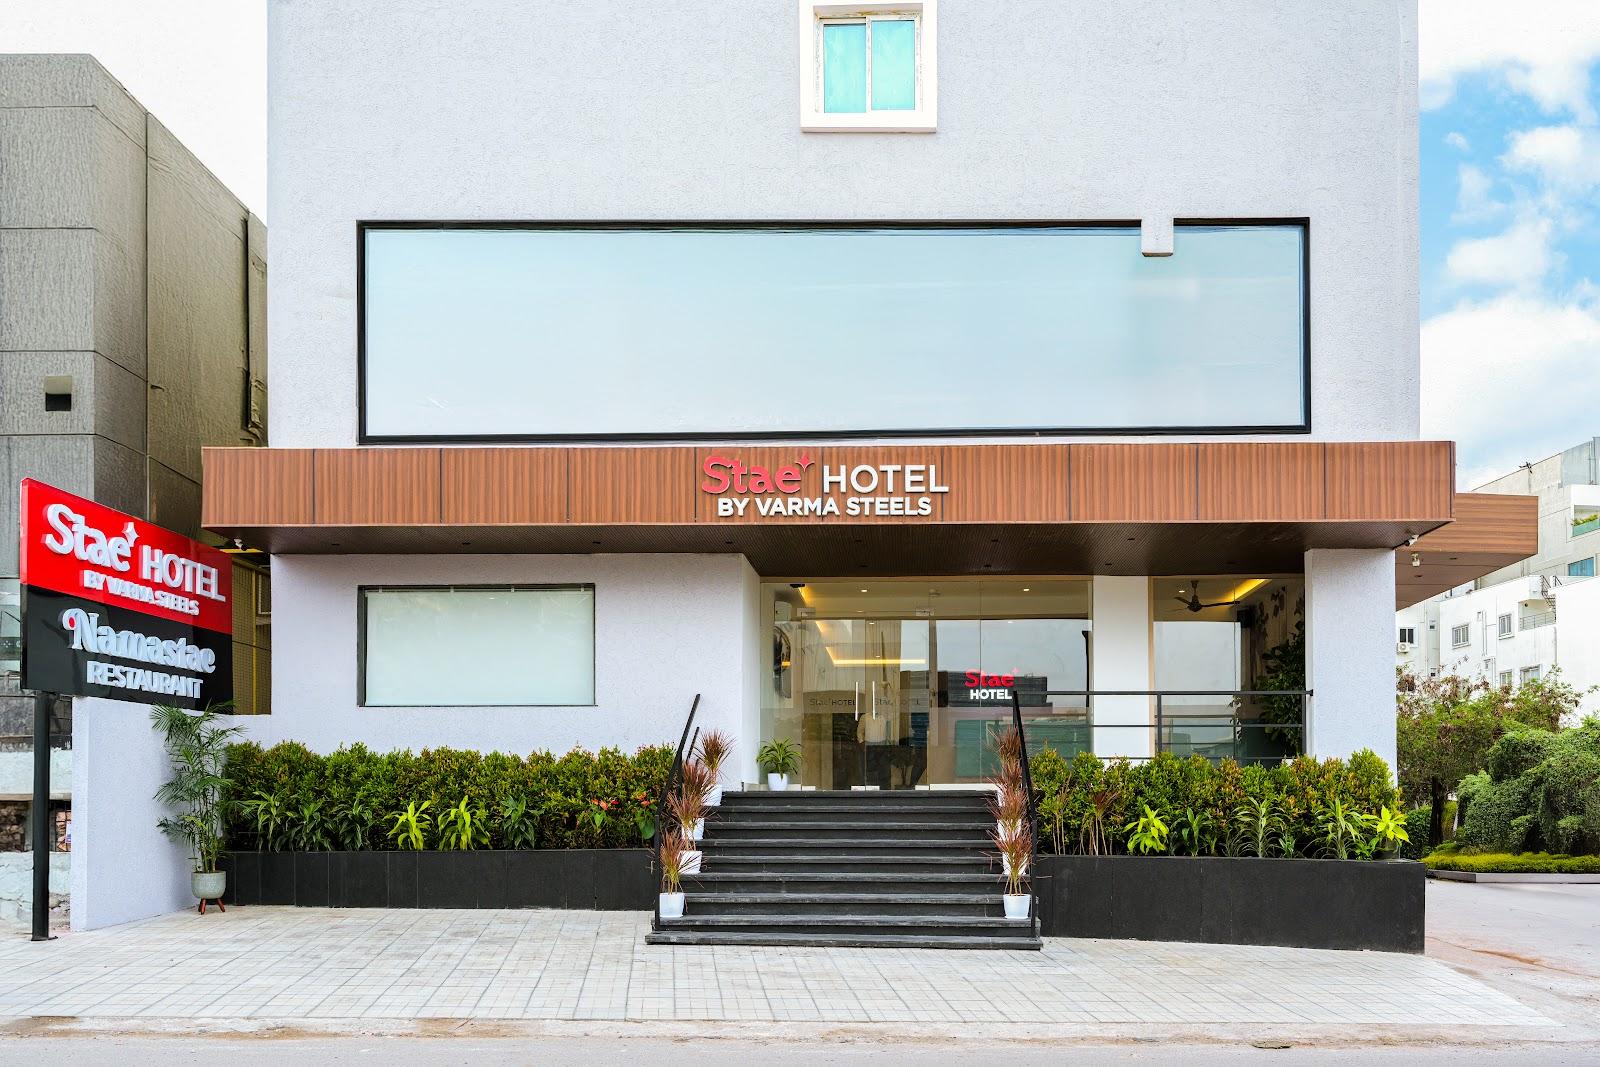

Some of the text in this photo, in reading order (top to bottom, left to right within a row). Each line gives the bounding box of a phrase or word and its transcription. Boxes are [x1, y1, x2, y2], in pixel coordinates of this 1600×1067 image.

[701, 455, 950, 494] Stae HOTEL
[717, 496, 932, 517] BY VARMA STEELS
[42, 503, 226, 602] Stae HOTEL
[82, 570, 200, 615] BY VARMA STEELS
[62, 607, 216, 674] Namastae
[86, 660, 203, 699] RESTAURANT
[965, 669, 1015, 688] Stae
[970, 688, 1013, 700] HOTEL
